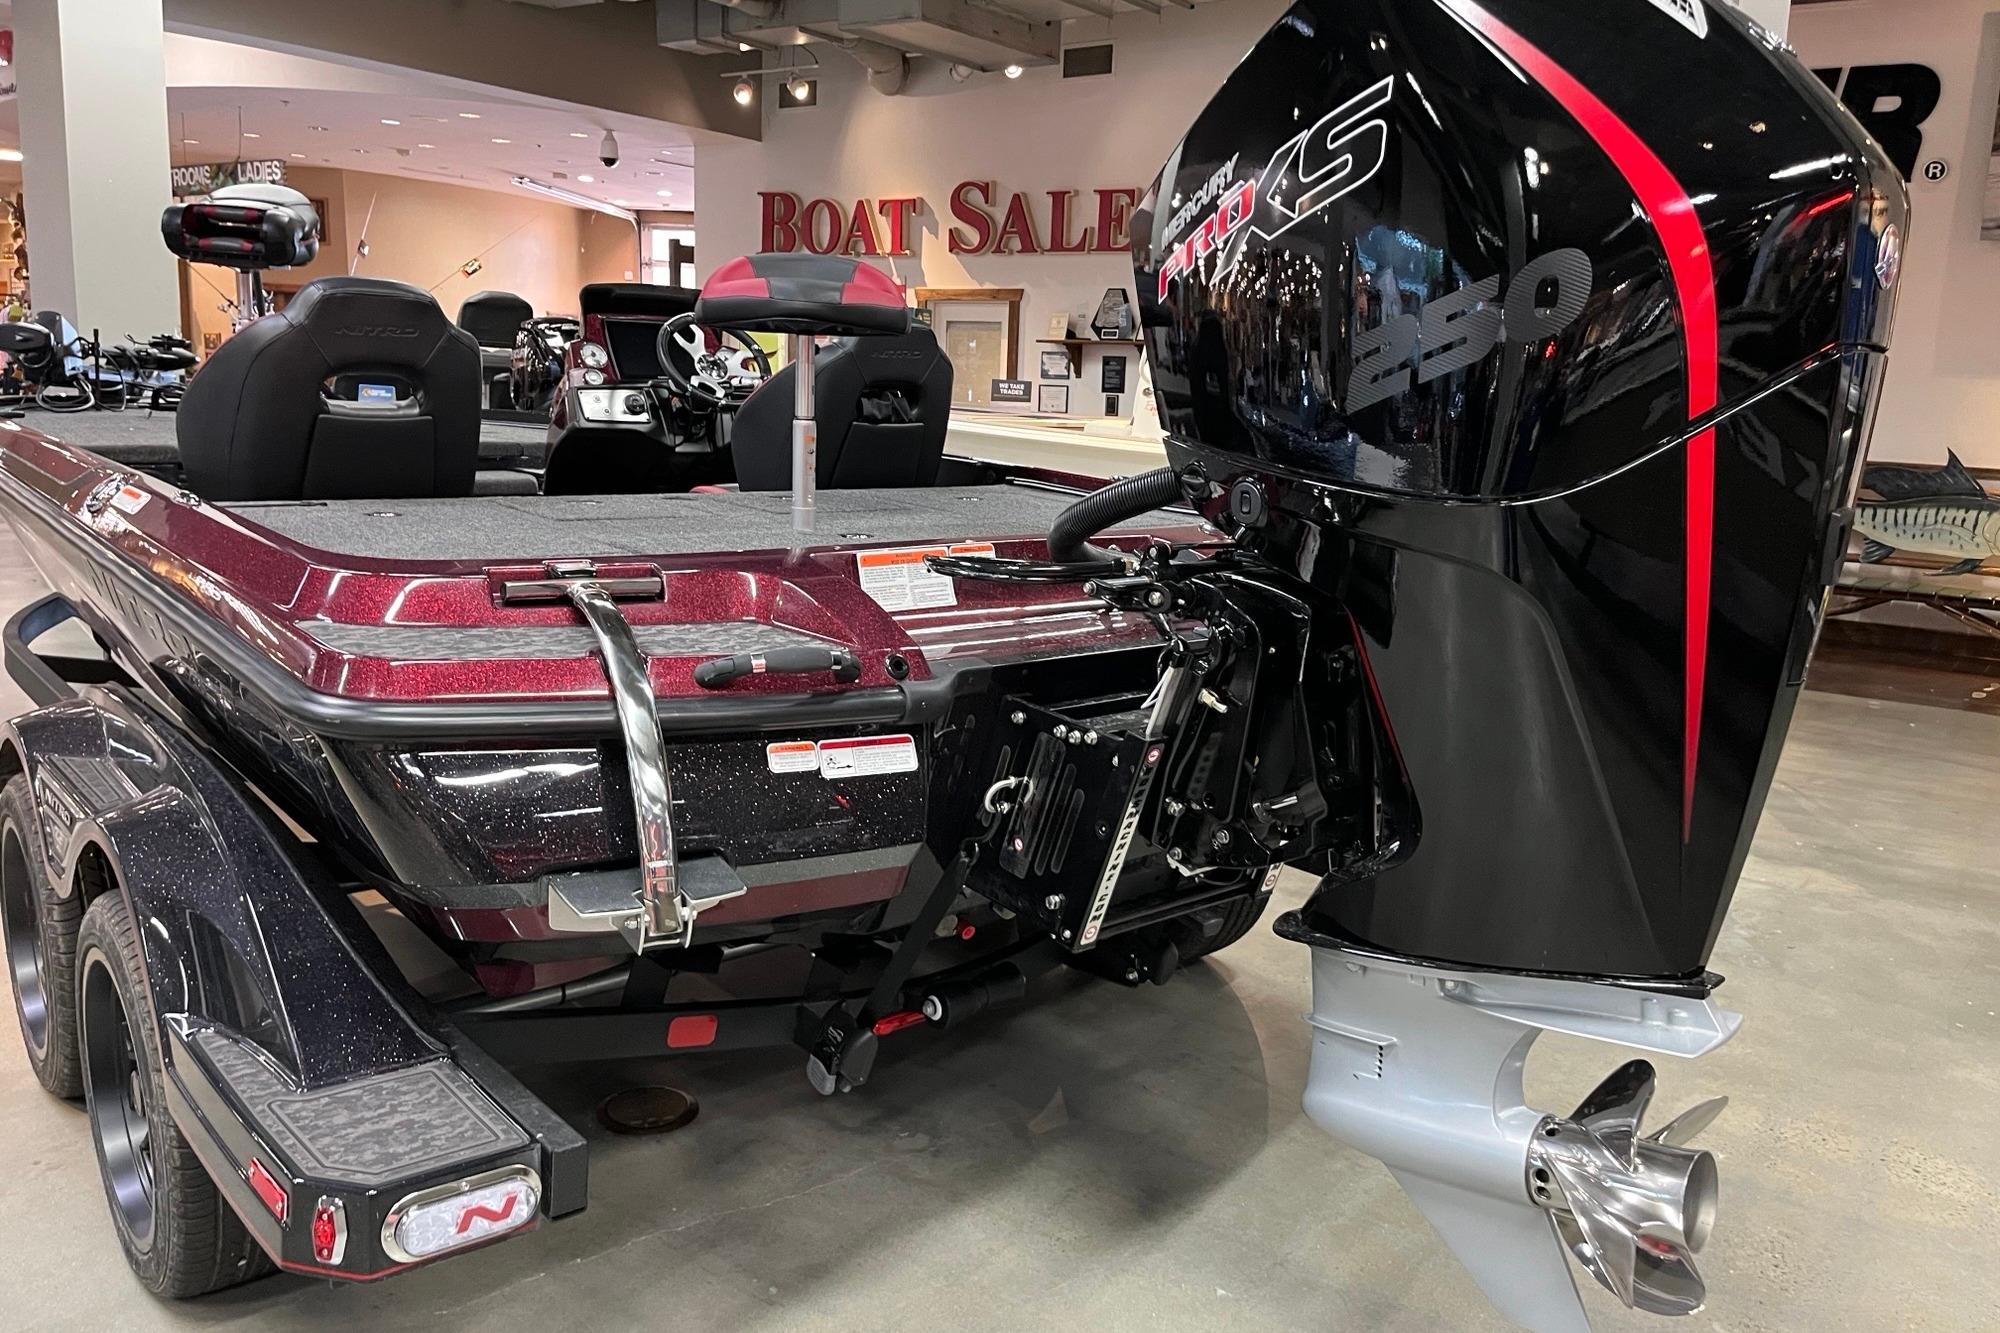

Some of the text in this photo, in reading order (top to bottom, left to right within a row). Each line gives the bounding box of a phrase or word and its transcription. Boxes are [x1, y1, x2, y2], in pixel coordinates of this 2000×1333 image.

[237, 160, 281, 182] LADIES
[1161, 151, 1240, 250] MERCURY
[757, 191, 918, 256] BOAT
[1344, 247, 1593, 416] 250
